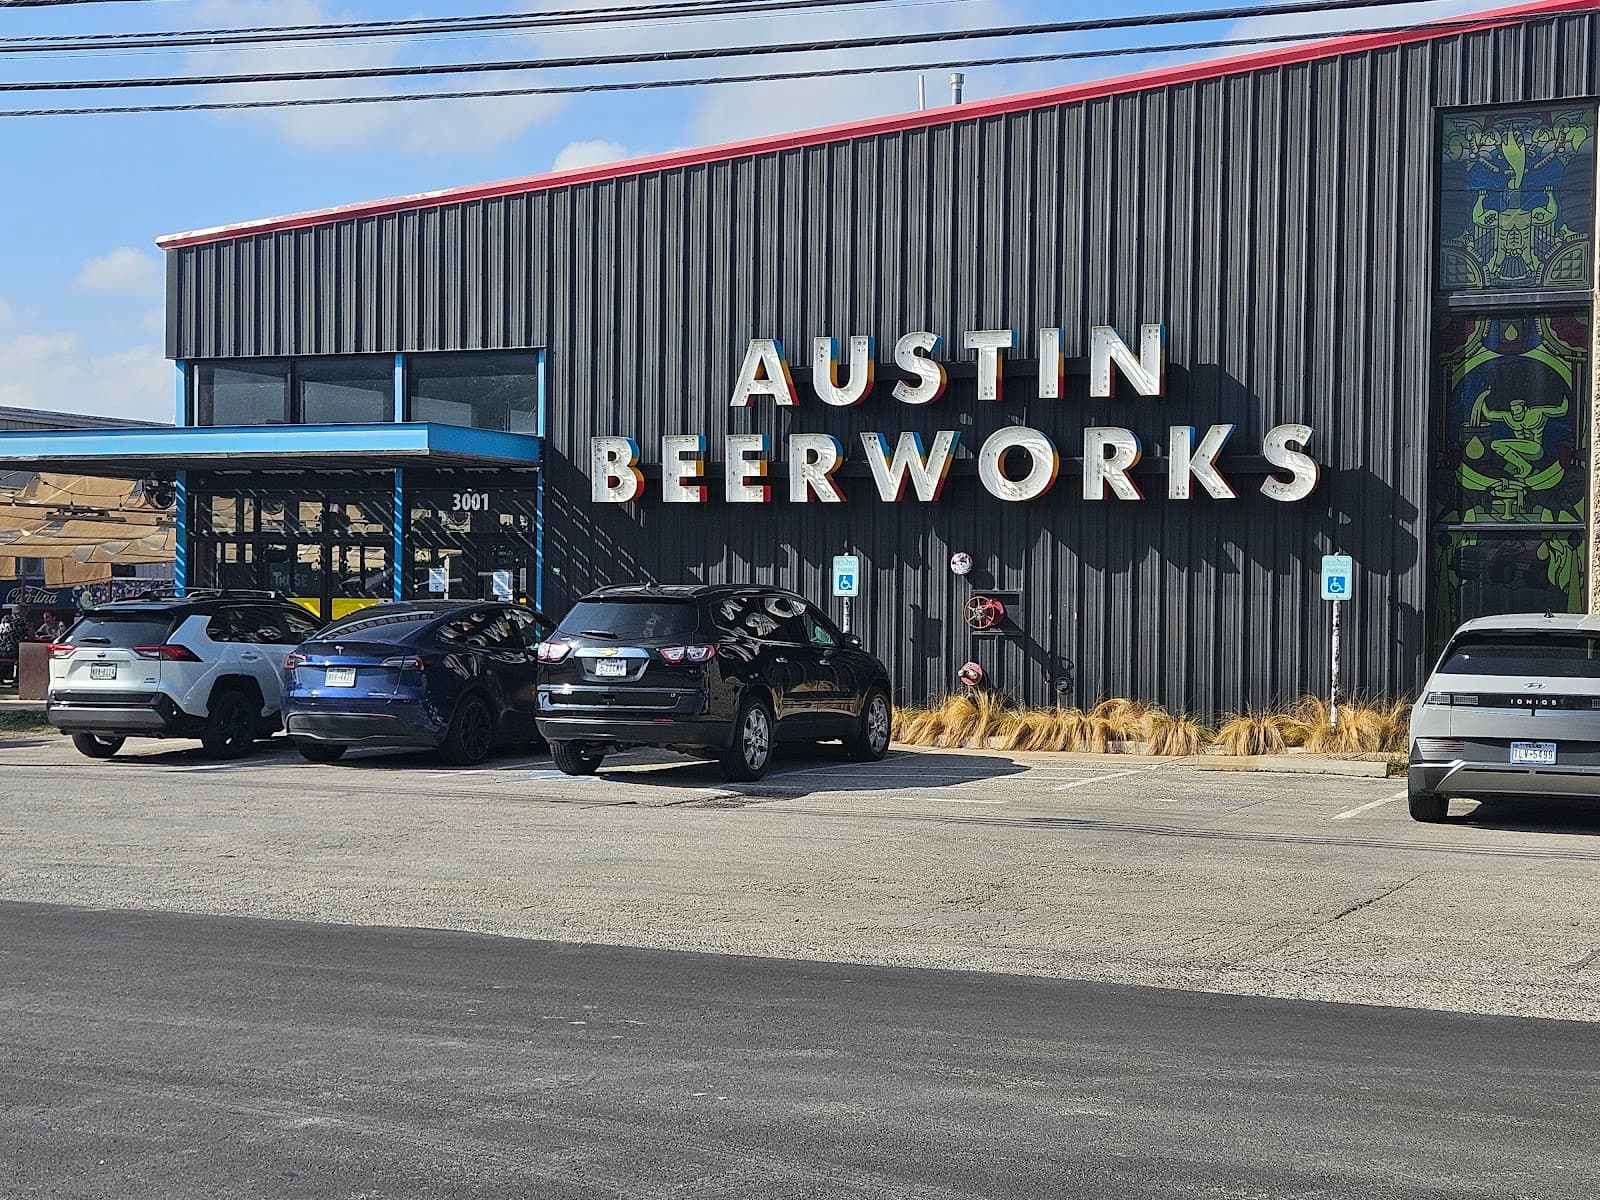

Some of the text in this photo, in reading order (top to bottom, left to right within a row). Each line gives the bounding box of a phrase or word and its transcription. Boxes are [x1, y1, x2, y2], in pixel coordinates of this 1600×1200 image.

[730, 323, 1166, 407] AUSTIN
[451, 492, 489, 511] 3001
[591, 423, 1321, 503] BEERWORKS
